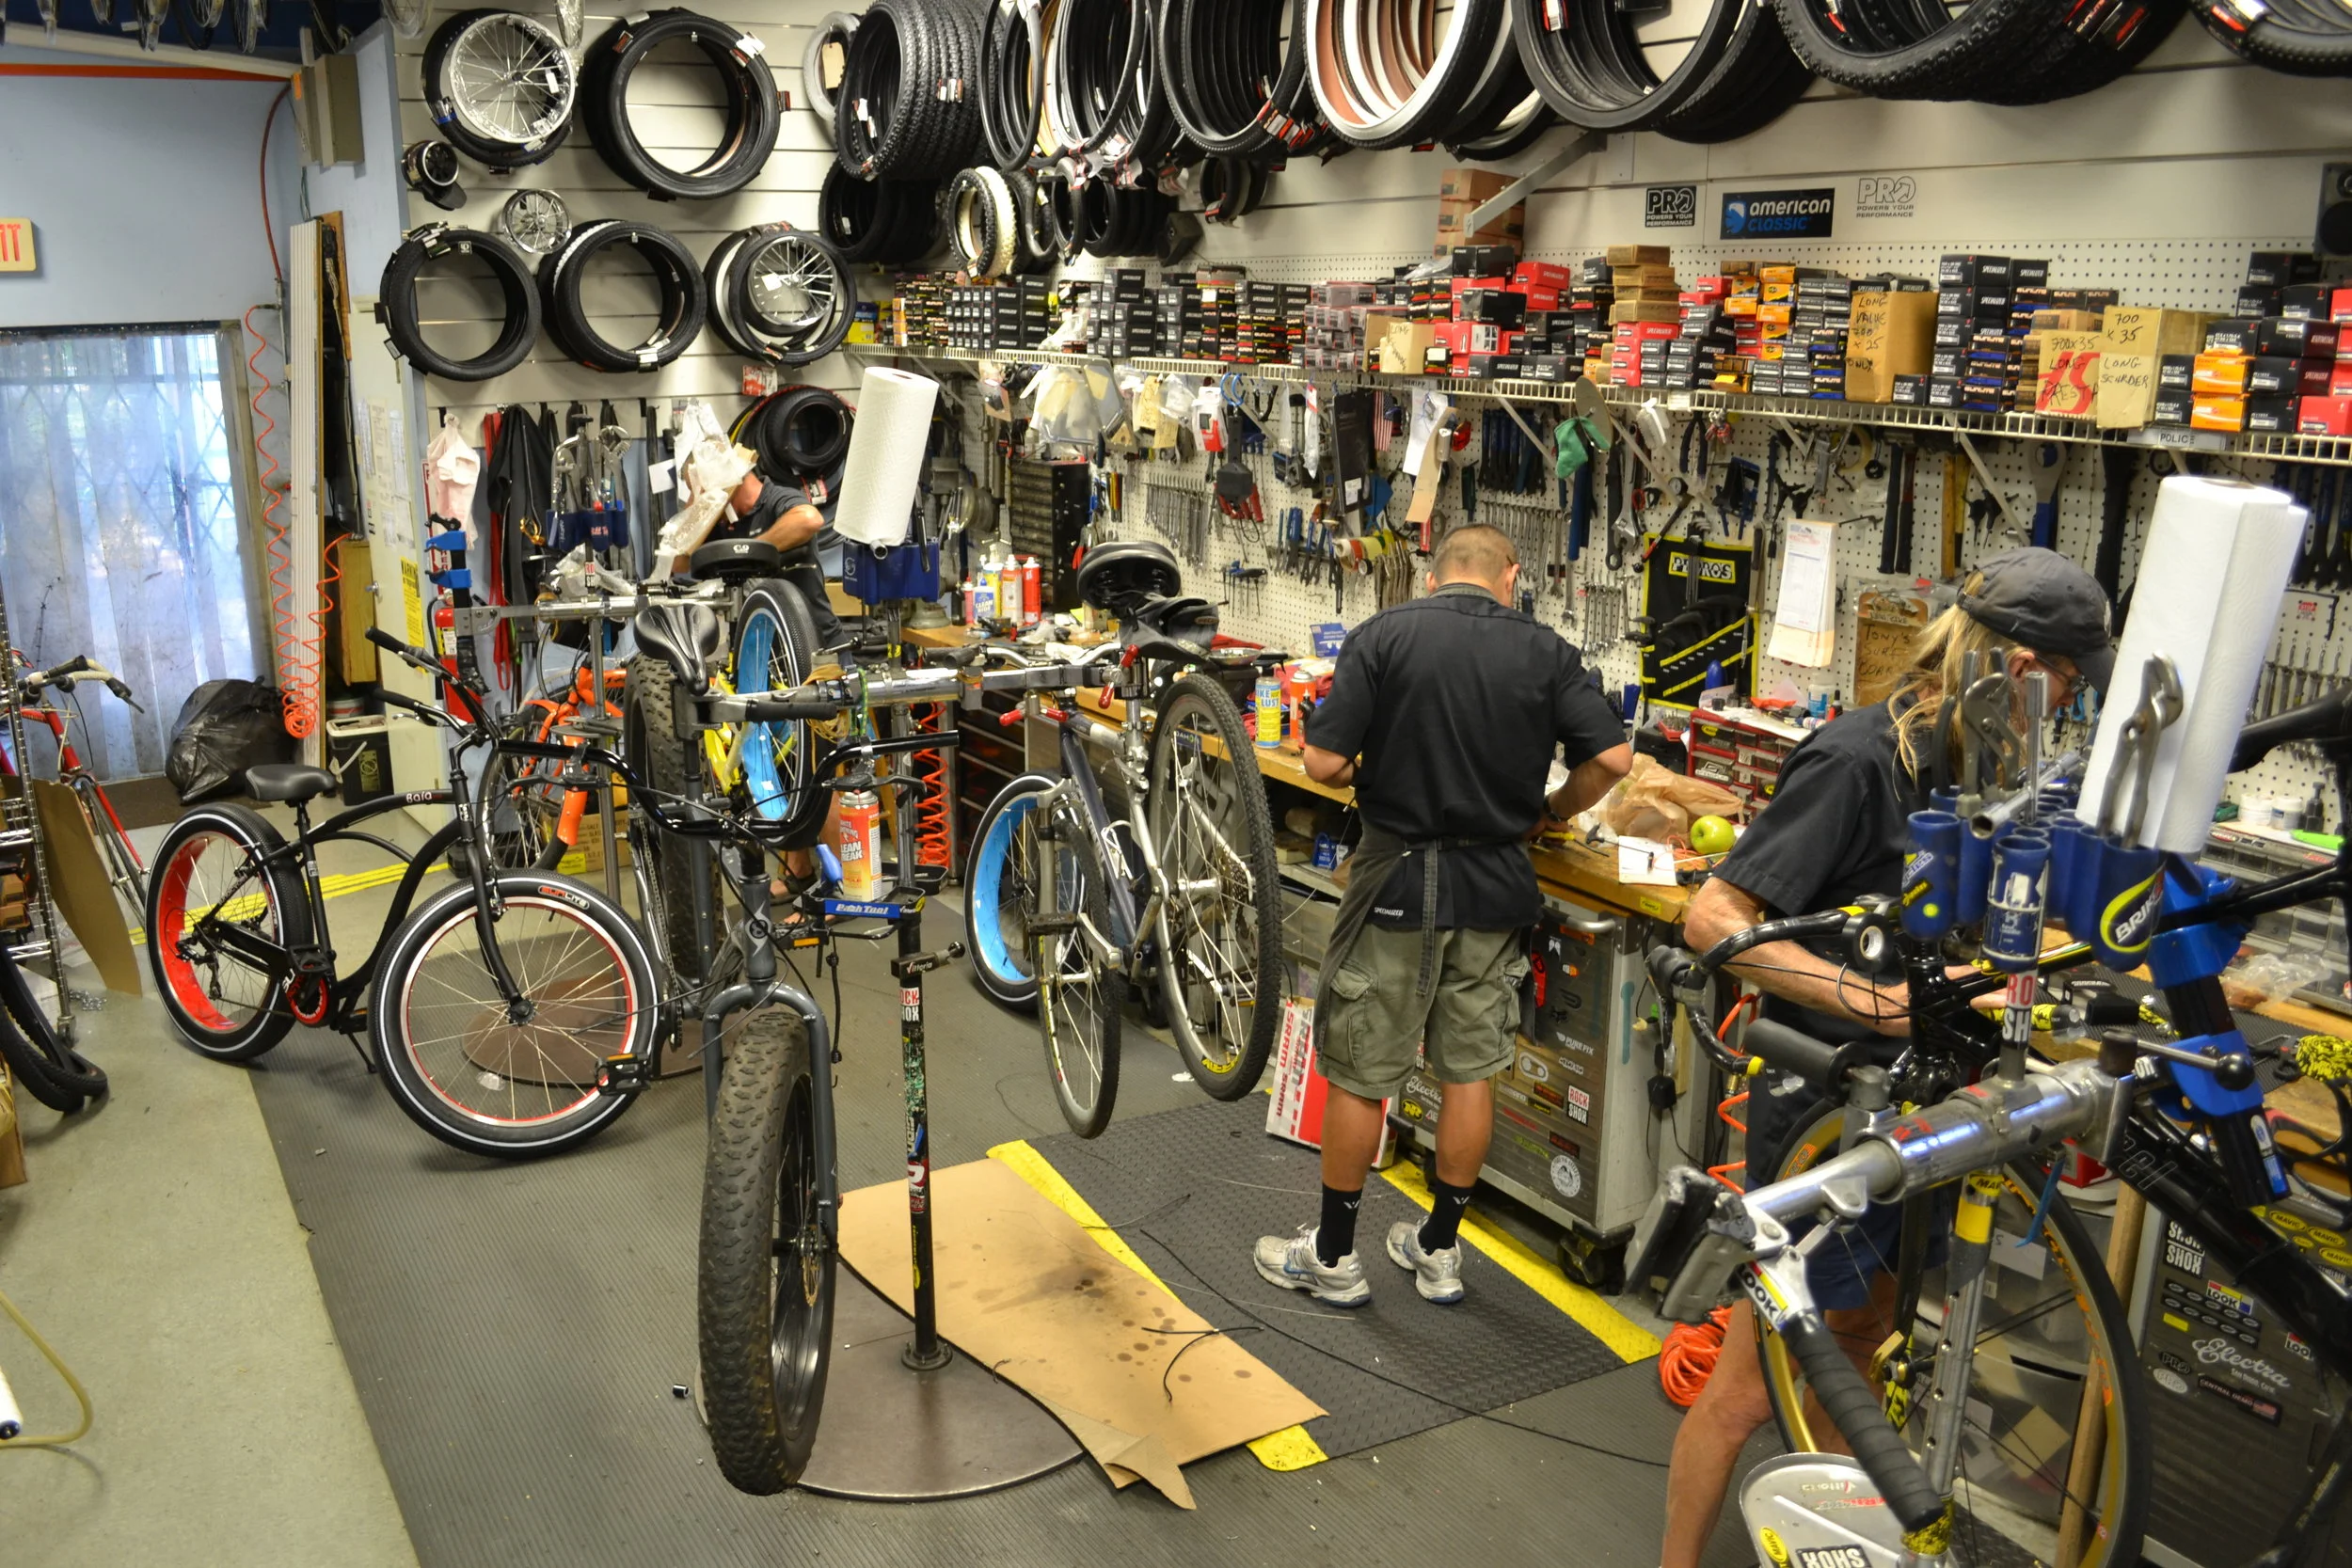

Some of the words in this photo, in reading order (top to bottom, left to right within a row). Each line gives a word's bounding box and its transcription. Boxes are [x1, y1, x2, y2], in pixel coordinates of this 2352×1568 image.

[1857, 177, 1916, 204] PRO
[1646, 188, 1695, 214] PRO
[1749, 198, 1831, 215] american
[2116, 313, 2139, 325] 700
[2120, 326, 2143, 343] 35
[1866, 338, 1879, 350] 25
[2049, 356, 2085, 370] LONG
[2104, 357, 2141, 369] LONG
[585, 563, 595, 574] RO
[586, 577, 595, 586] SH
[1261, 699, 1279, 707] LUST
[841, 841, 862, 852] LEAN
[864, 905, 888, 914] Tool
[1374, 907, 1404, 916] SPECIALIZED
[907, 961, 932, 974] Vittoria
[900, 989, 919, 1006] OCK
[2007, 974, 2035, 1006] RO
[2002, 1009, 2030, 1044] SH
[1279, 1011, 1295, 1068] SRAM
[1276, 1072, 1288, 1117] SRAM
[1569, 1088, 1589, 1107] ROCK
[1568, 1105, 1588, 1125] SHOX
[2276, 1214, 2301, 1228] MAVIC
[2314, 1230, 2339, 1243] MAVIC
[2166, 1244, 2203, 1275] SHOX
[2327, 1252, 2351, 1263] MAVIC
[2207, 1287, 2239, 1308] LOOK
[2286, 1341, 2312, 1360] LOO
[2192, 1338, 2291, 1387] Electra
[2200, 1378, 2230, 1396] CENTRAL
[1765, 1532, 1783, 1556] MAVIC
